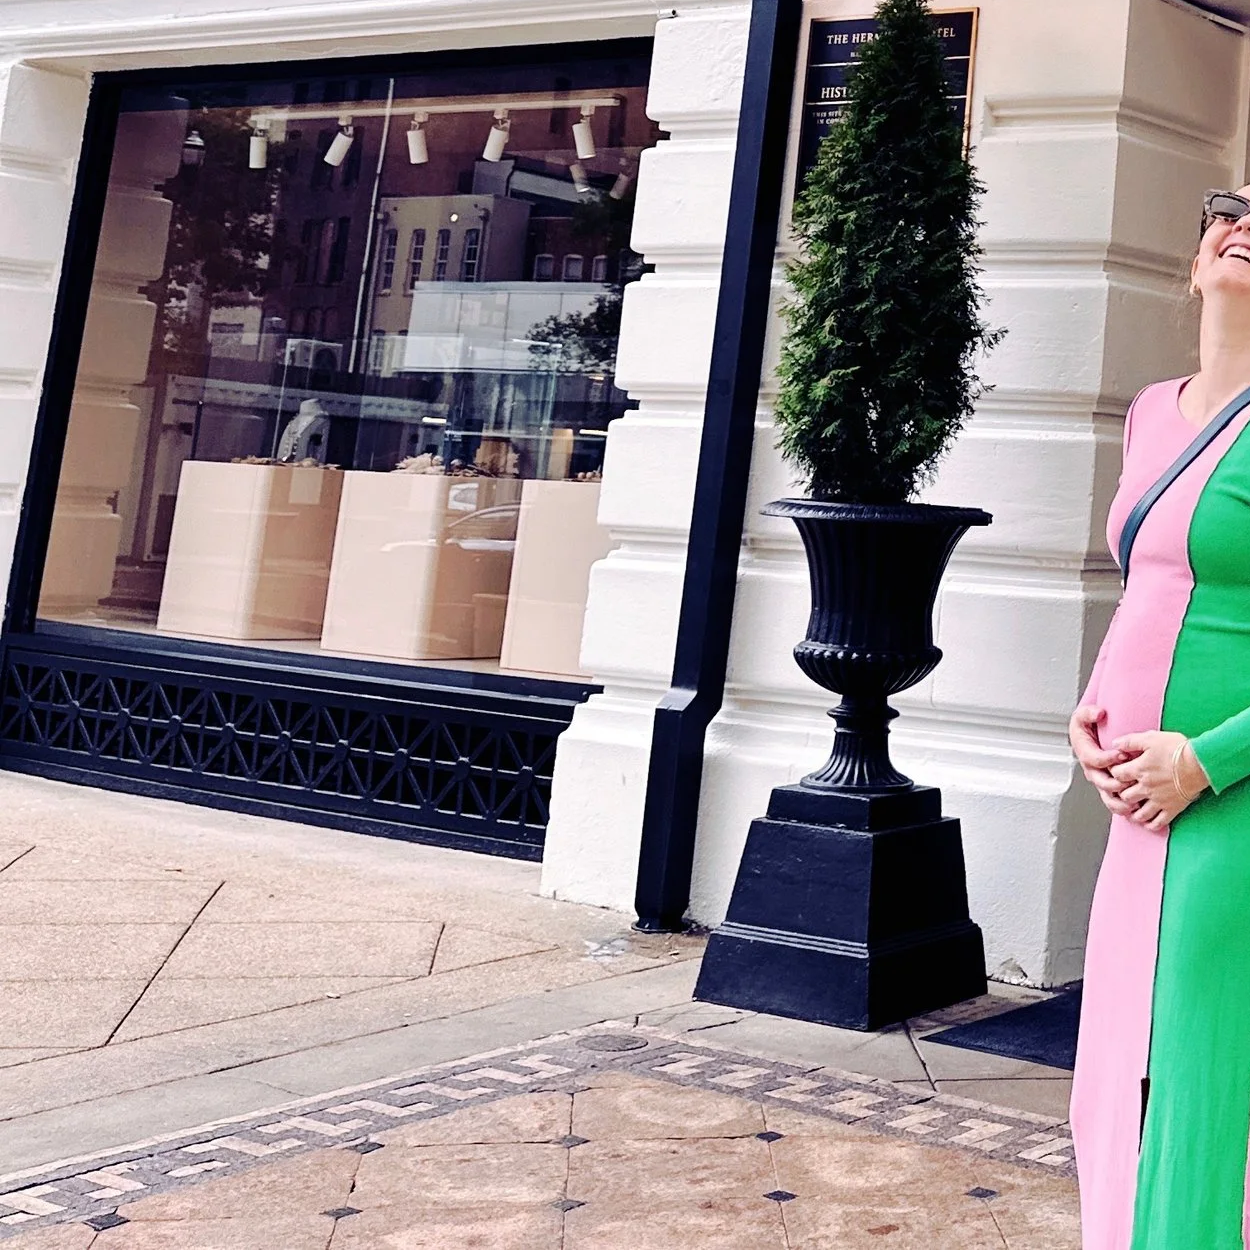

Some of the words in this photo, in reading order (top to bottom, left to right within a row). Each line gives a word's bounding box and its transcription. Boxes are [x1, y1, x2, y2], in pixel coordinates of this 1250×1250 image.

[827, 34, 848, 45] THE
[937, 28, 956, 38] TEL
[821, 87, 848, 99] HIST
